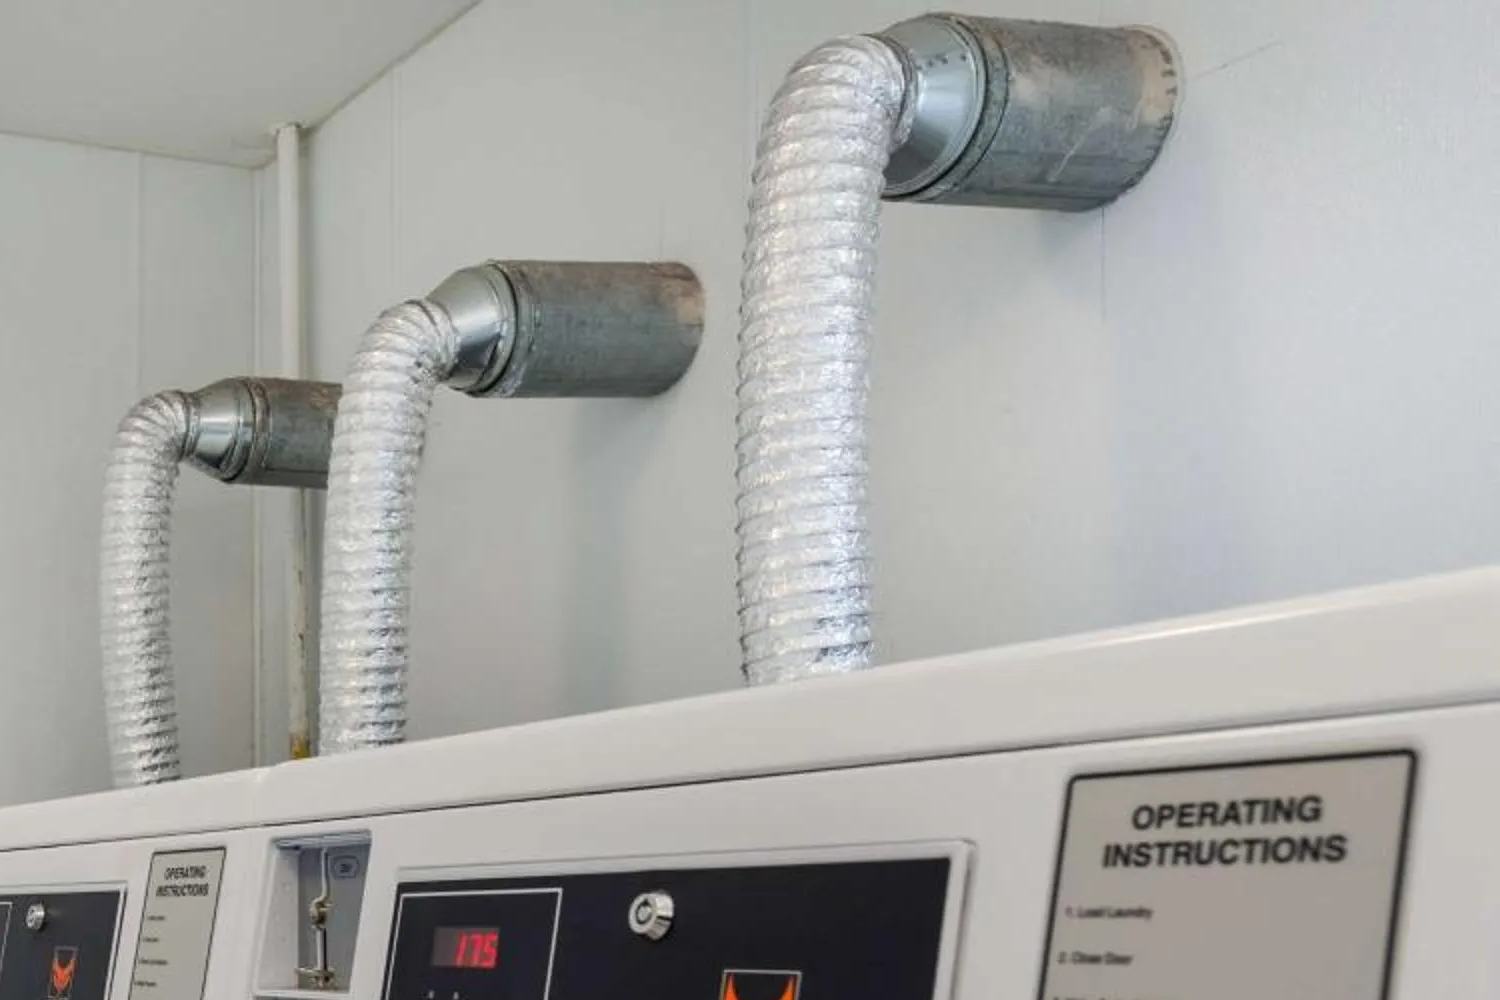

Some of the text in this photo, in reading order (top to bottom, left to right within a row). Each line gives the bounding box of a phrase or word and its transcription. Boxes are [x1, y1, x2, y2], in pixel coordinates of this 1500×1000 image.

[1130, 794, 1324, 830] OPERATING
[1102, 835, 1349, 869] INSTRUCTIONS
[1076, 907, 1106, 918] Load
[1107, 907, 1153, 920] Laundry
